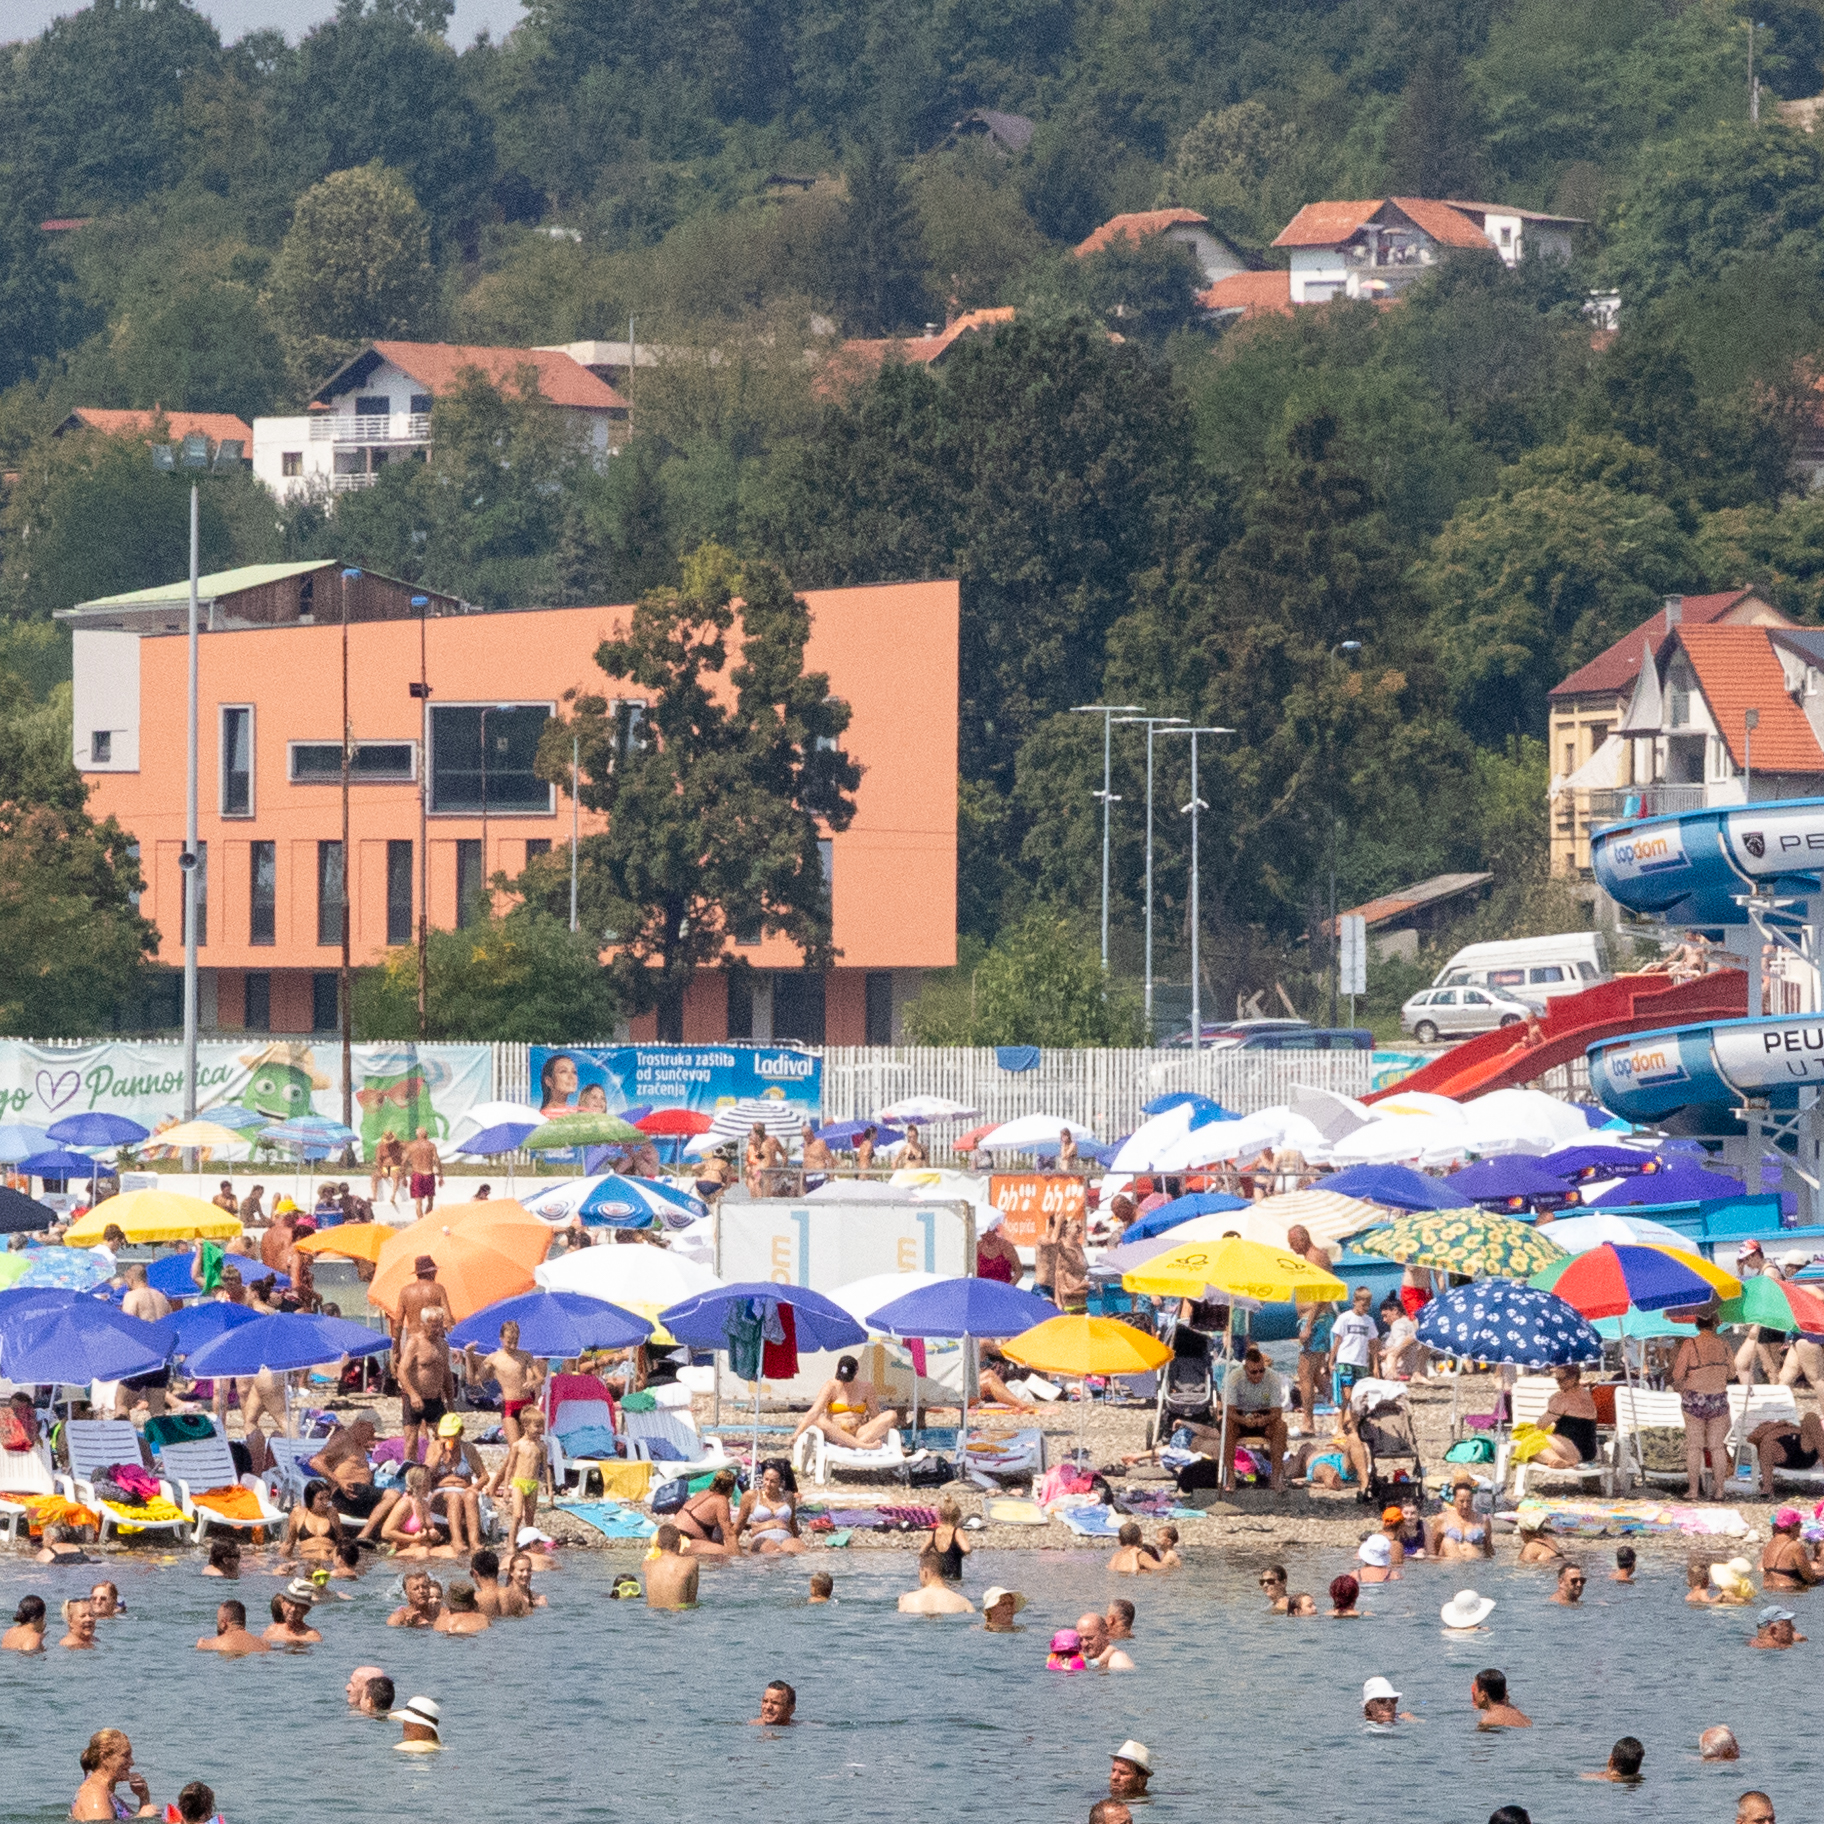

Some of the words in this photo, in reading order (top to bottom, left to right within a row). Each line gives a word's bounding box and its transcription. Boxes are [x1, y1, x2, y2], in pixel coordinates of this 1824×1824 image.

[1614, 834, 1668, 865] topdom
[636, 1053, 692, 1067] Trostruka
[695, 1053, 735, 1067] zaštita
[754, 1053, 813, 1076] Ladival
[1612, 1050, 1666, 1077] topdom
[1786, 1060, 1809, 1077] U
[636, 1070, 653, 1081] od
[655, 1069, 711, 1082] sunčevog
[636, 1084, 686, 1097] zračenja
